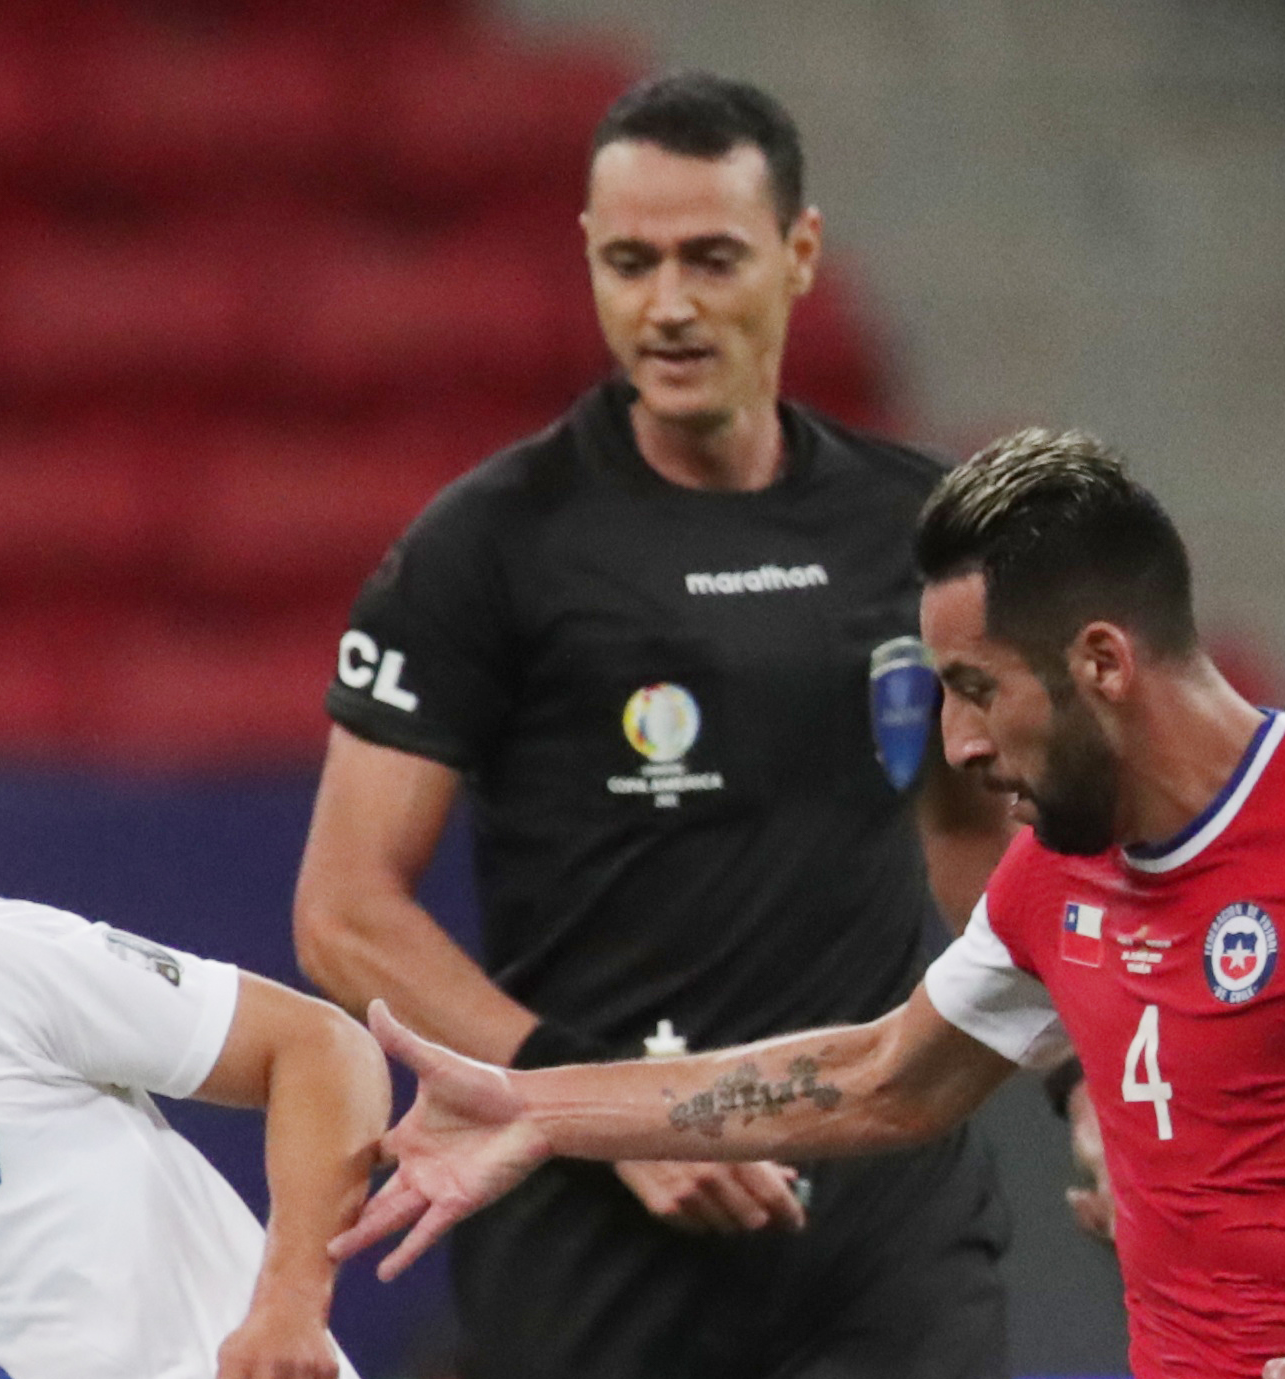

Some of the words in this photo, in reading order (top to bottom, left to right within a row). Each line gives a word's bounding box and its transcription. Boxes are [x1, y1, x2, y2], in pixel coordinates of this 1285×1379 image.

[684, 563, 829, 596] marathon
[338, 629, 419, 712] CL
[1121, 1004, 1172, 1141] 4
